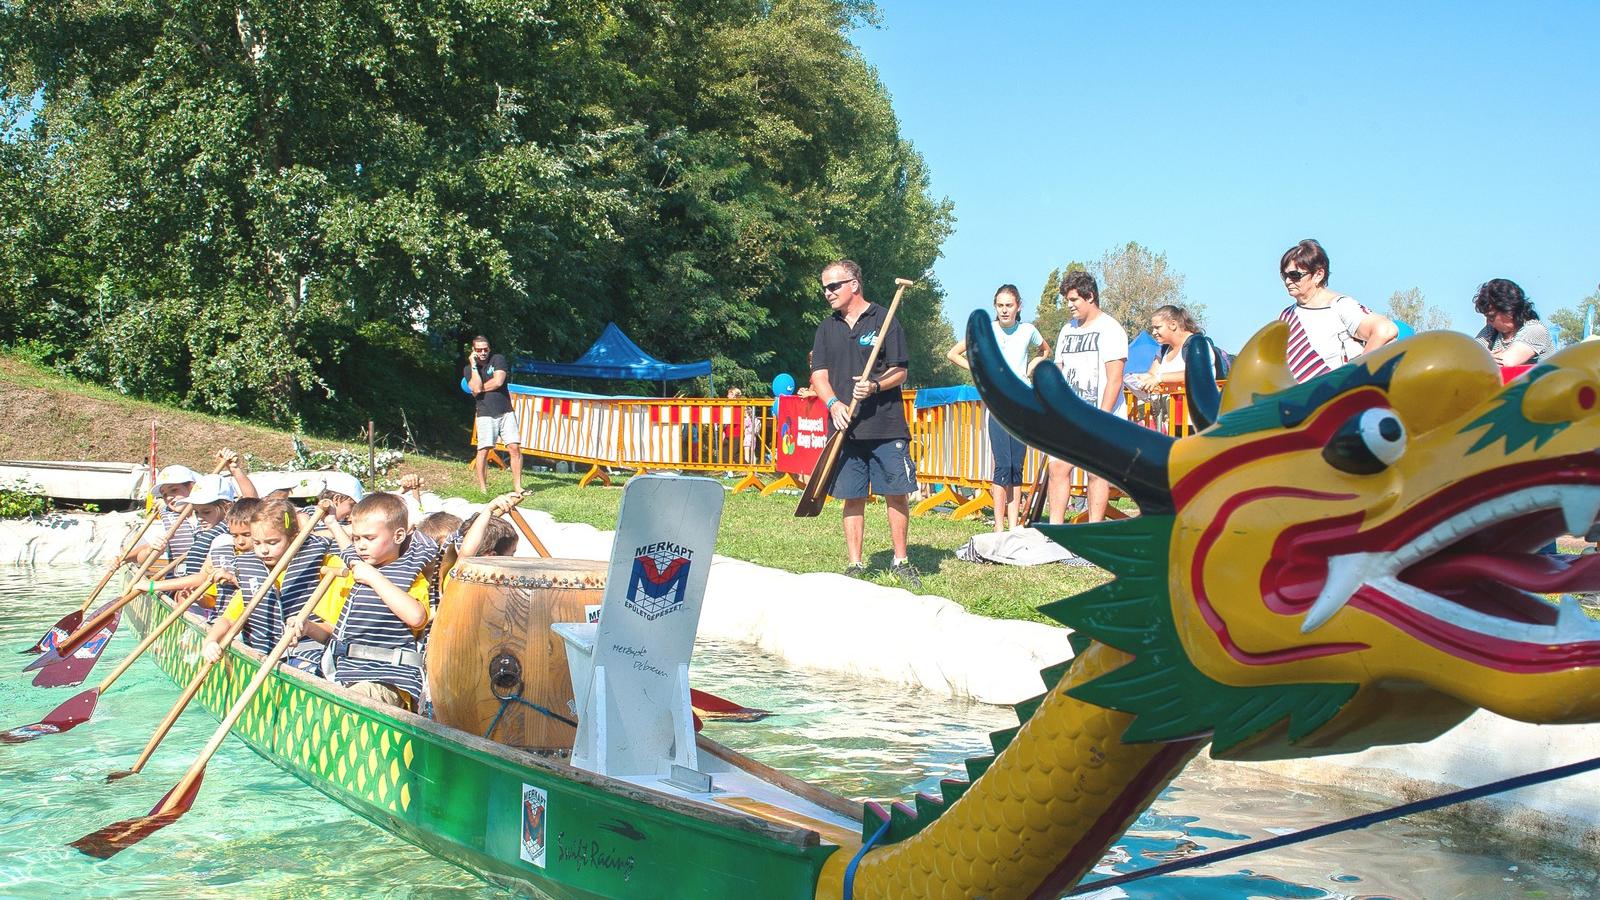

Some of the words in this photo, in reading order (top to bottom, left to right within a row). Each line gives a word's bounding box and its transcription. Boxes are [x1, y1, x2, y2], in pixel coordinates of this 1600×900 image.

[634, 541, 694, 560] MERKAPT
[558, 831, 588, 872] Swift
[590, 840, 635, 881] Racing
